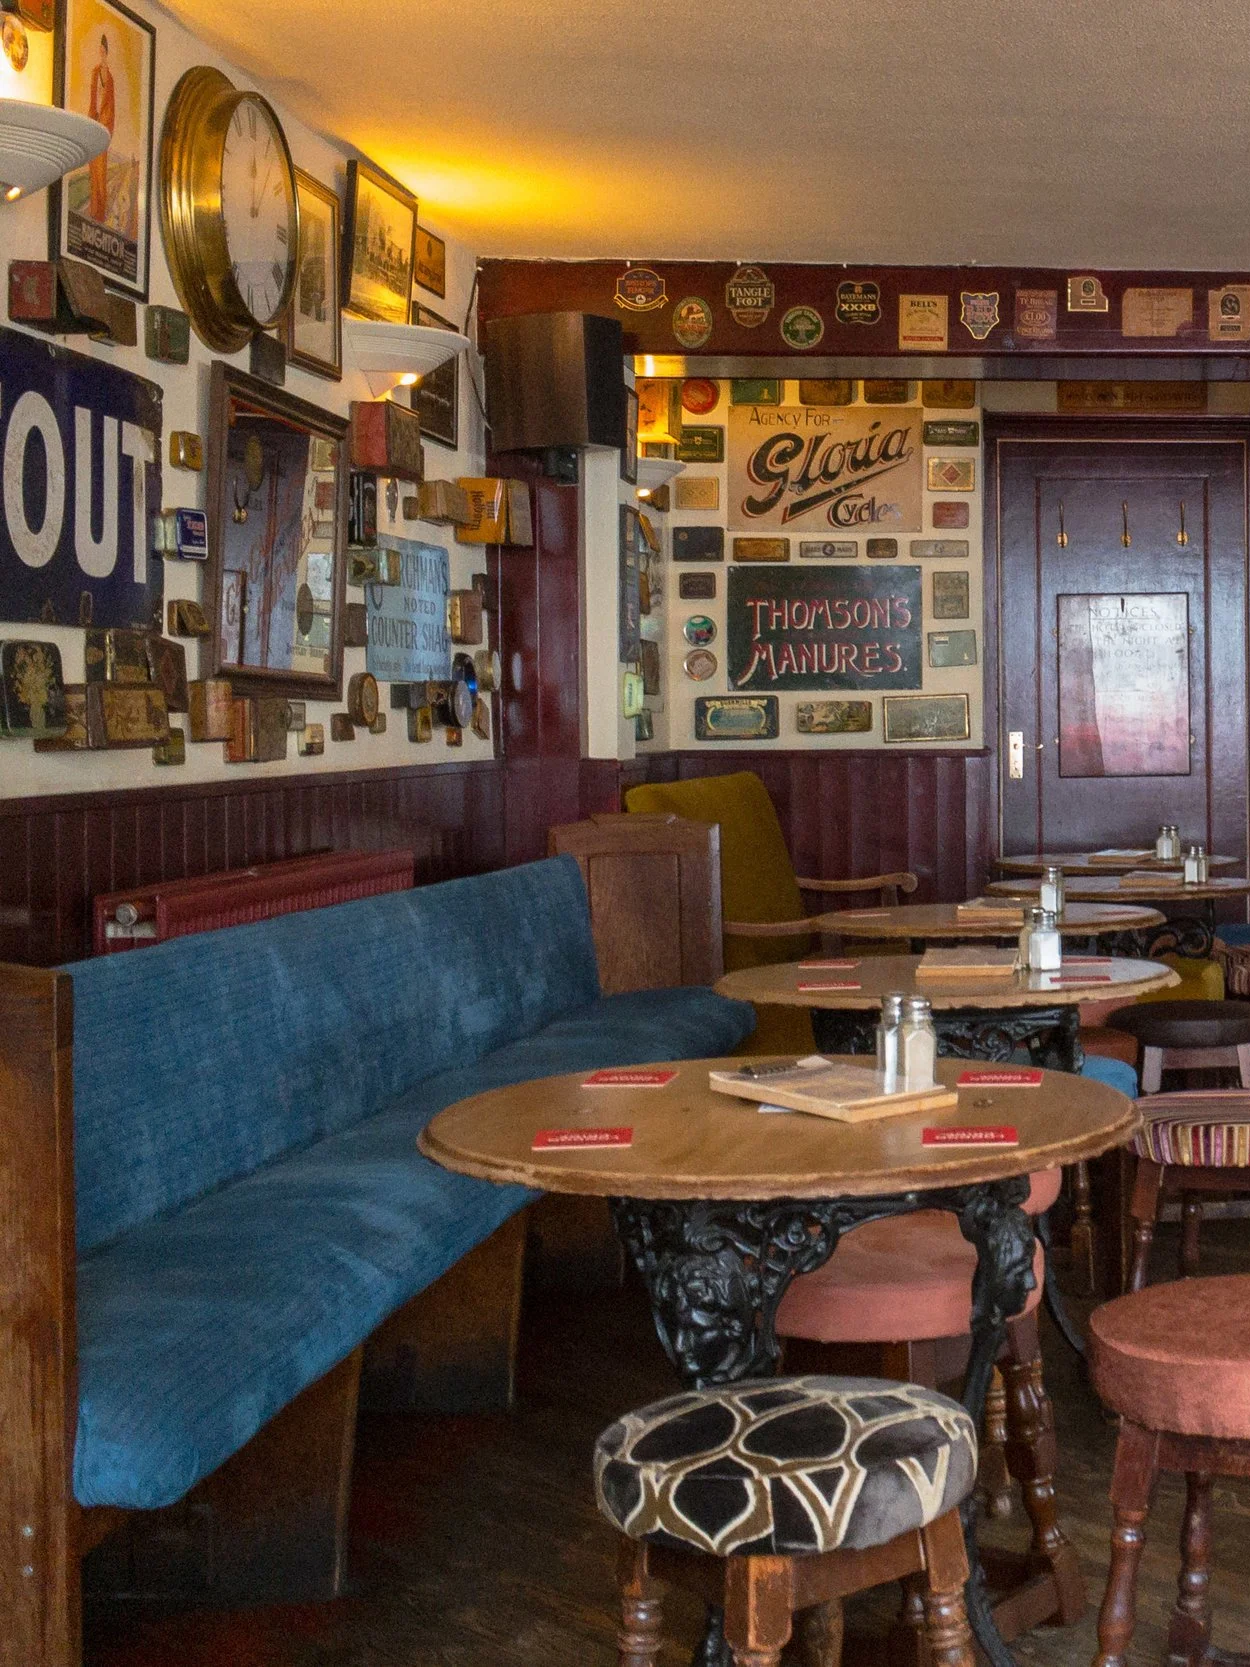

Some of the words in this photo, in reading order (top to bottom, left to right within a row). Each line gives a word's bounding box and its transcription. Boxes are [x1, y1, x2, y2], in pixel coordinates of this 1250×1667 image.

[729, 286, 771, 298] TANGLE
[736, 297, 764, 306] FOOT
[840, 303, 877, 311] XXXB
[741, 422, 913, 518] Gloria
[827, 494, 900, 528] Cycles
[404, 597, 436, 616] NOTED
[1089, 606, 1159, 618] NOTICES
[746, 597, 912, 641] THOMSON'S
[371, 616, 418, 651] COUNTER
[422, 621, 449, 651] SHAG
